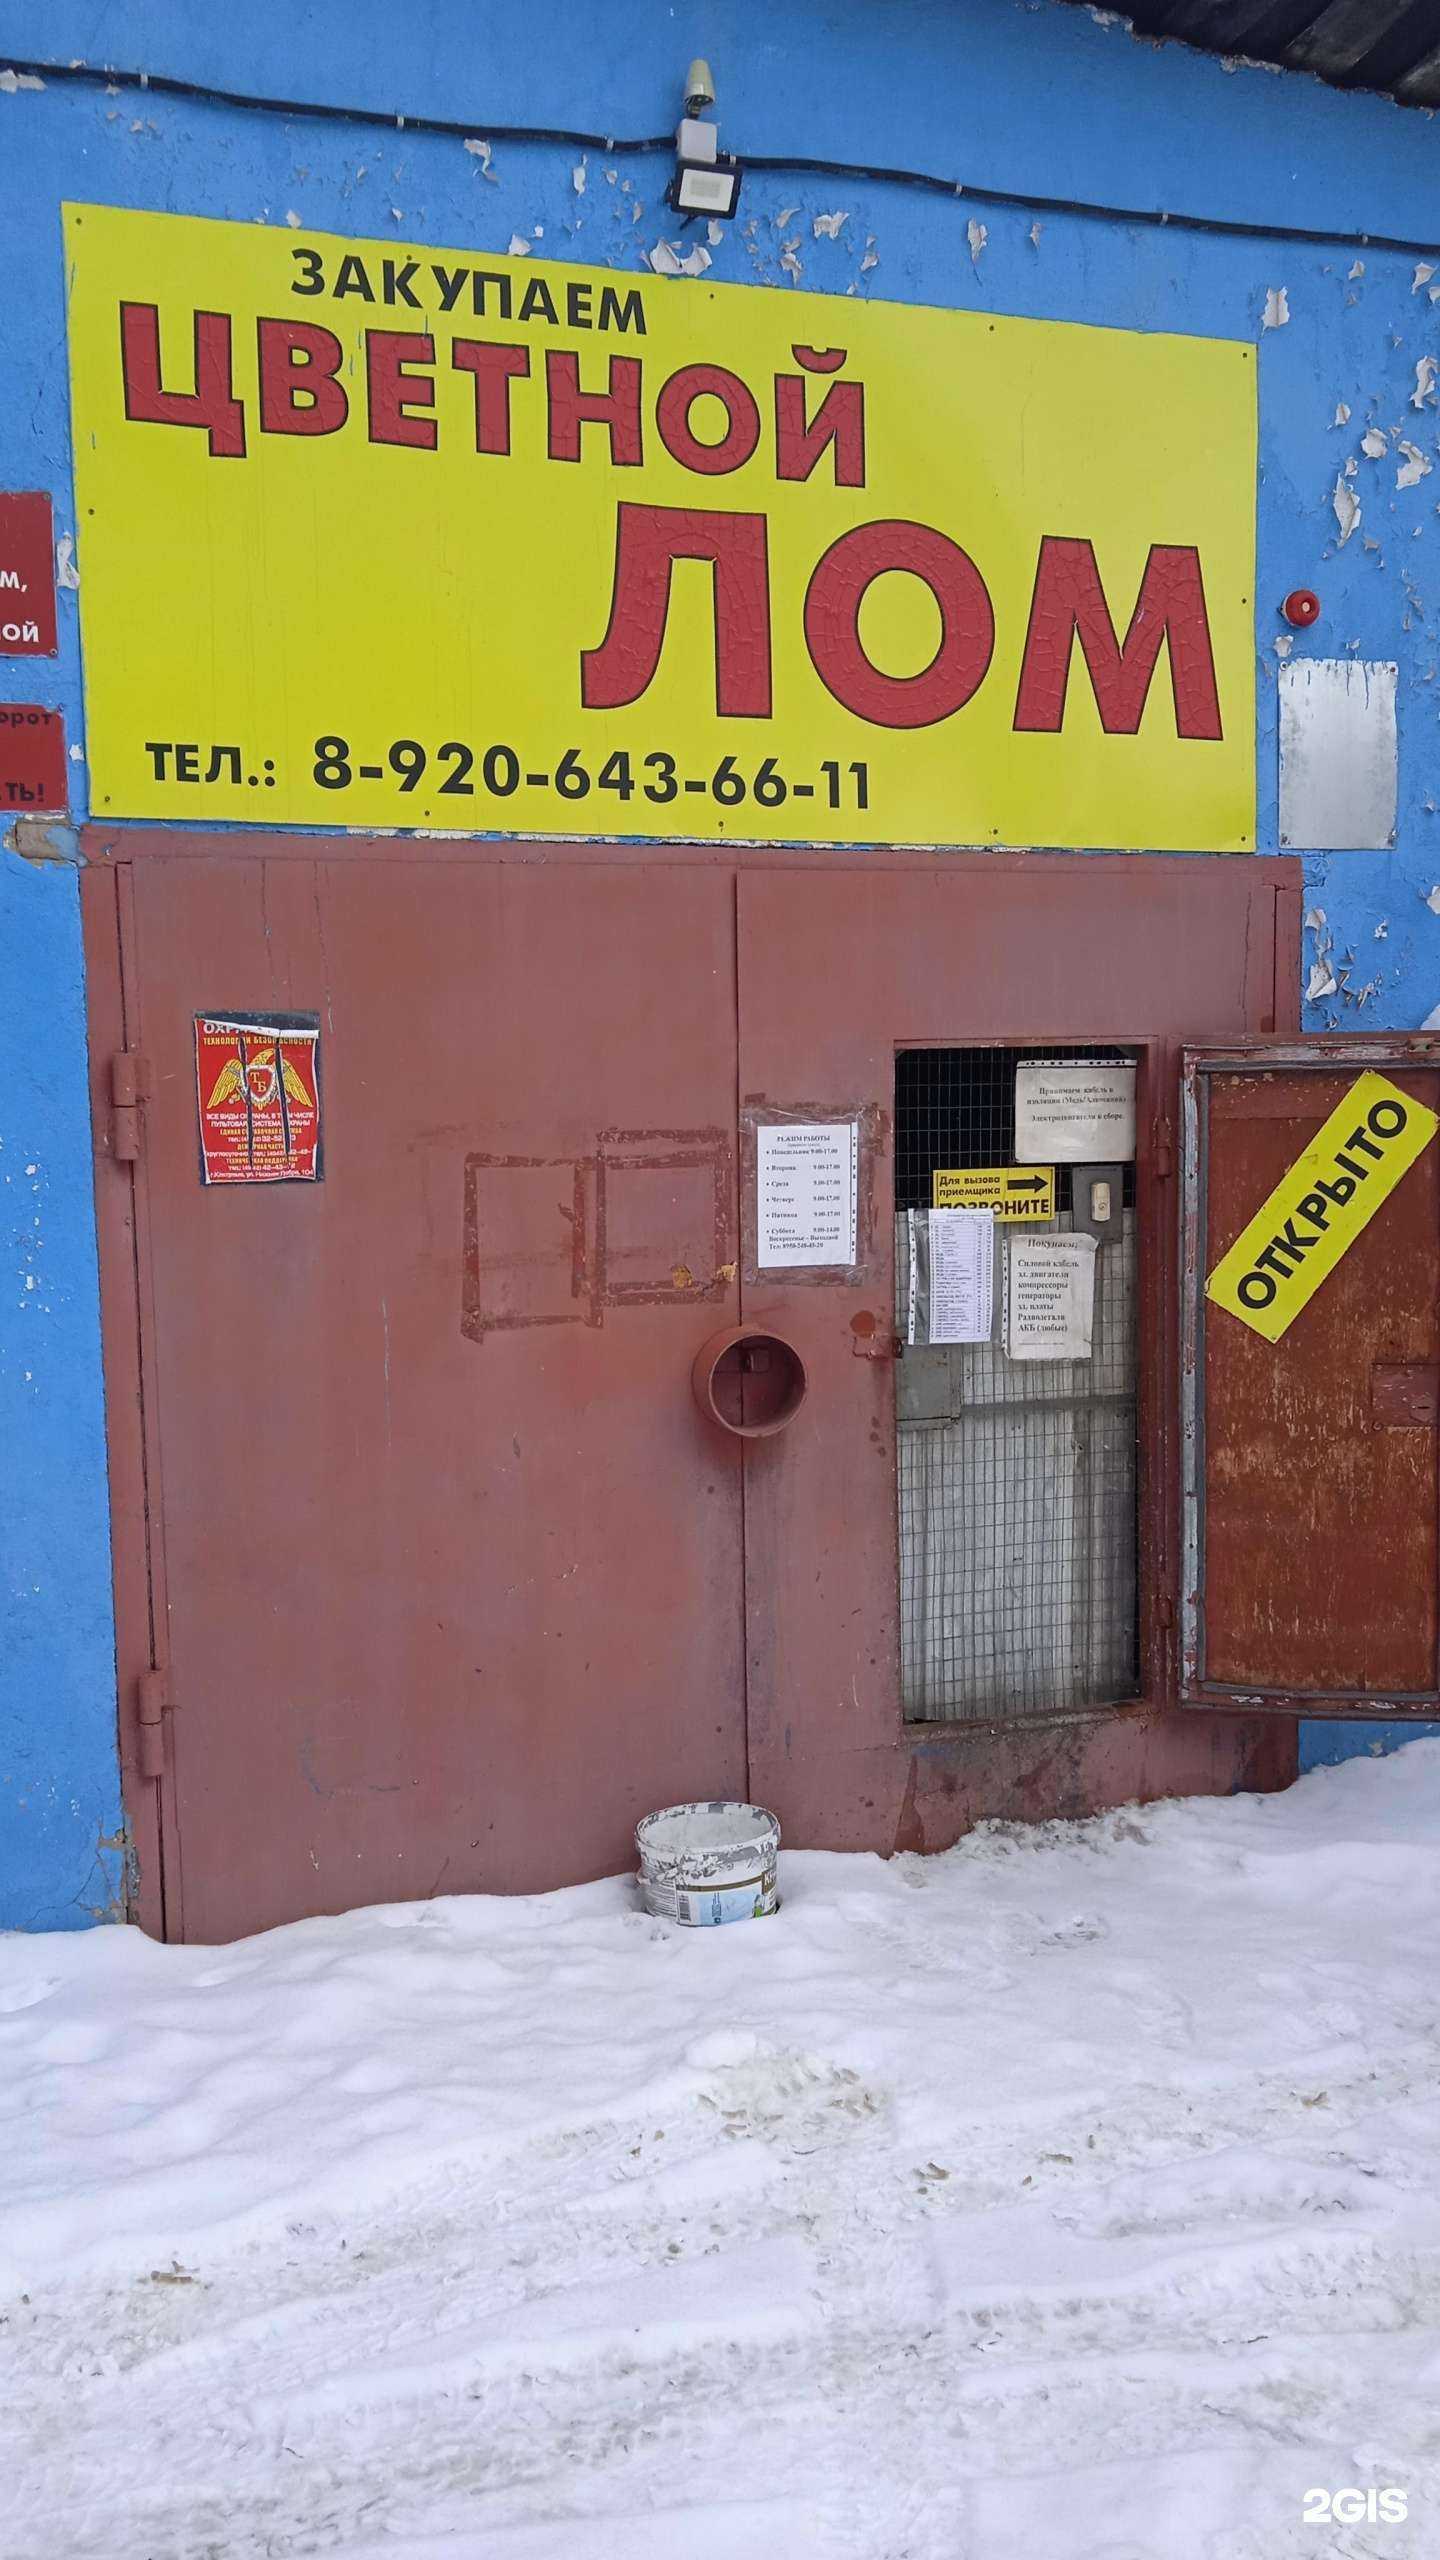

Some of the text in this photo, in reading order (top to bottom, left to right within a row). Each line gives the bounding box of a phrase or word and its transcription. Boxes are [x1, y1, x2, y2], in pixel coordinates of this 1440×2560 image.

[291, 248, 647, 335] ЗАКУПАЕМ
[119, 300, 866, 488] ЦВЕТНОЙ
[580, 500, 1223, 741] ЛОМ
[0, 782, 44, 802] ТЬ!
[145, 735, 869, 810] ТЕЛ.: 8-920-643-66-11
[203, 1037, 251, 1046] ТЕХНОЛОГИ
[940, 1176, 1000, 1186] Для вызова
[940, 1187, 1001, 1198] приемщика
[1237, 1100, 1407, 1310] ОТКРЫТО
